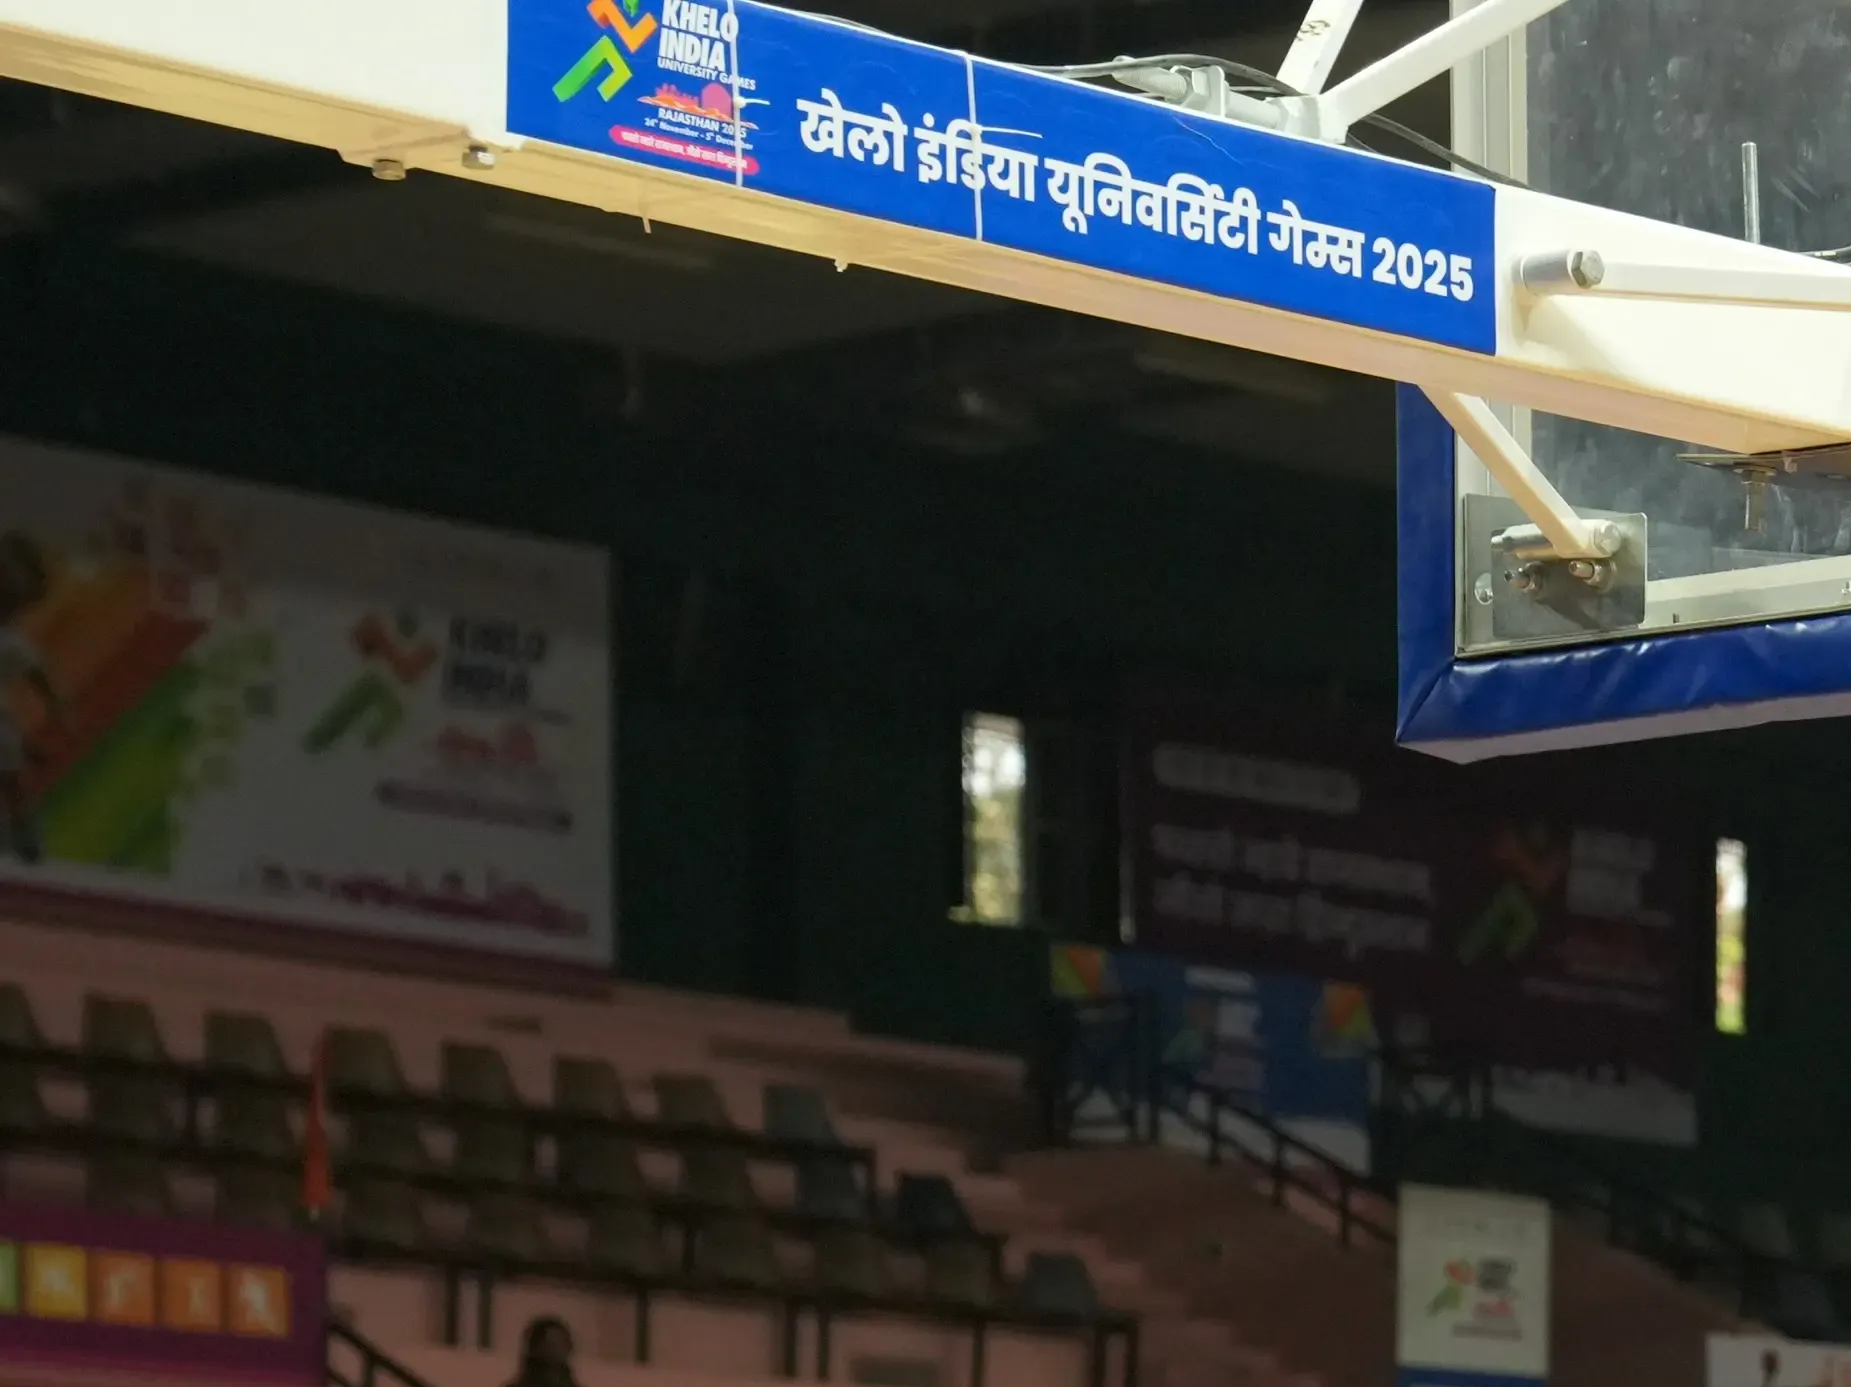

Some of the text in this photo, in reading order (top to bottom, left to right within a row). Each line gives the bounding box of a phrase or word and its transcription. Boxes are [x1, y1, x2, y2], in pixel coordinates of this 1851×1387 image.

[662, 0, 739, 42] KHELO
[659, 28, 726, 71] INDIA
[657, 57, 718, 82] UNIVERSITY
[658, 108, 747, 139] RAJASTHAN 205
[716, 134, 753, 150] Deceber
[796, 88, 908, 172] खेलो
[914, 112, 1038, 202] इंडिया
[1046, 152, 1261, 255] यूनिवर्सिटी
[1267, 199, 1365, 278] गेम्स
[1372, 237, 1474, 301] 2025
